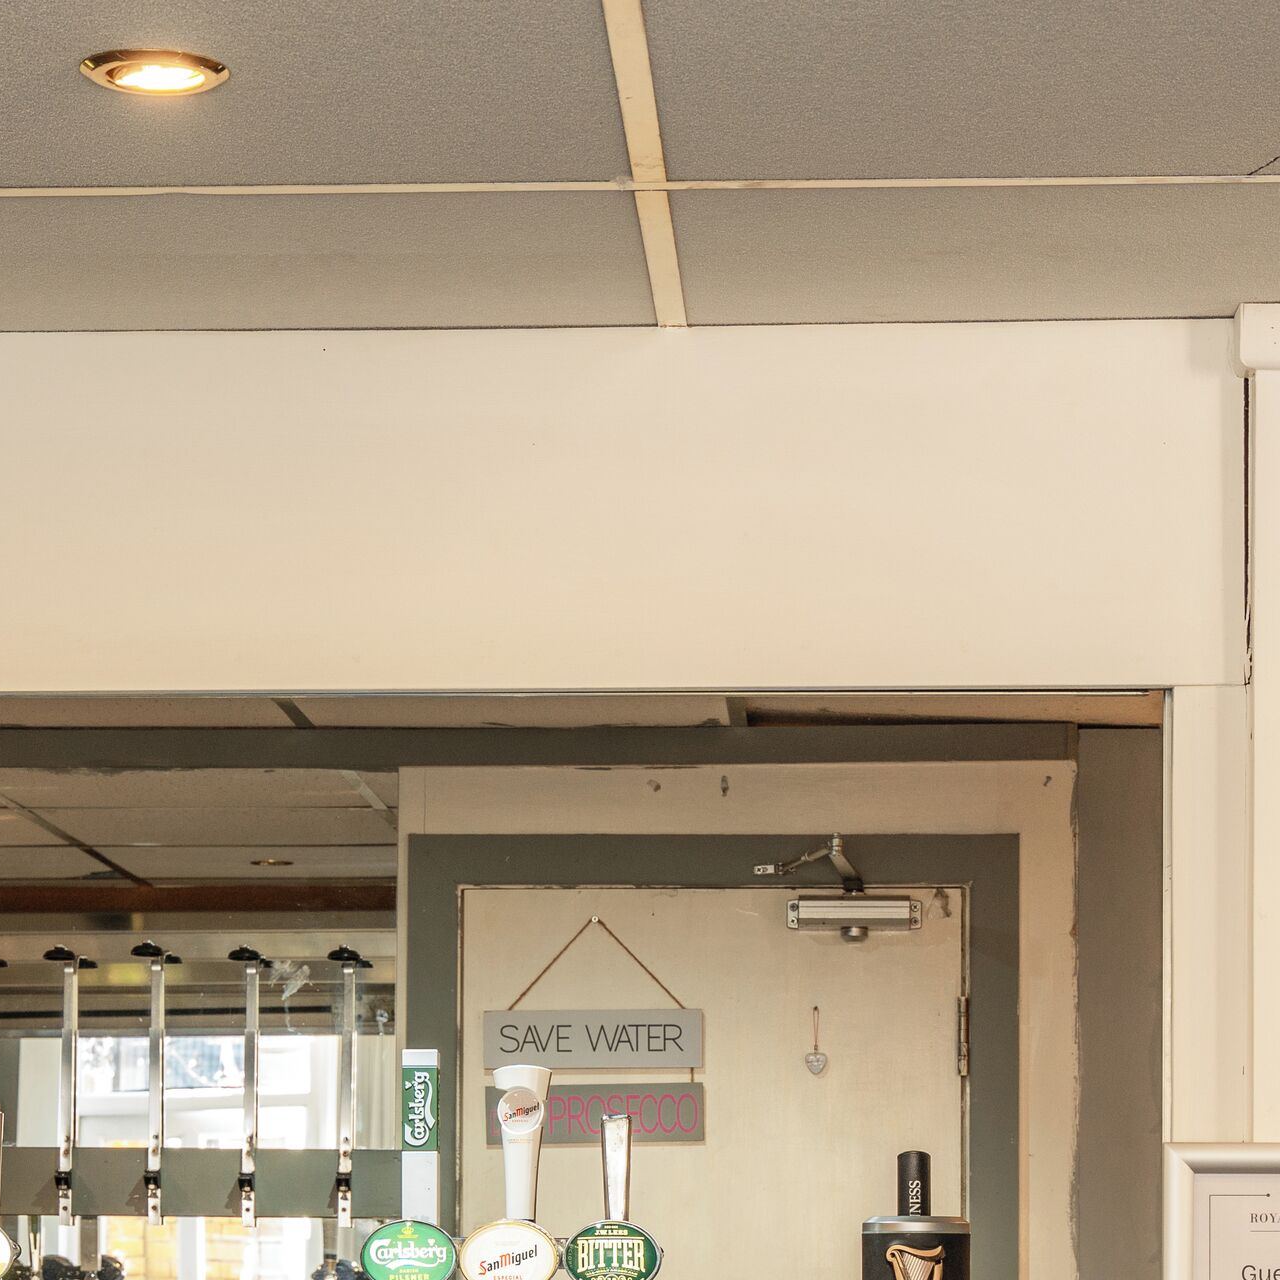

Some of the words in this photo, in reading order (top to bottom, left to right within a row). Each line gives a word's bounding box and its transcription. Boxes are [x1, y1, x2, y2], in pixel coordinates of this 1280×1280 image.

[499, 1024, 572, 1053] SAVE
[585, 1024, 684, 1052] WATER
[404, 1071, 429, 1146] Carlsberg
[370, 1238, 447, 1265] Carlsberg
[577, 1239, 646, 1273] BITTER
[389, 1273, 429, 1280] PILSNER
